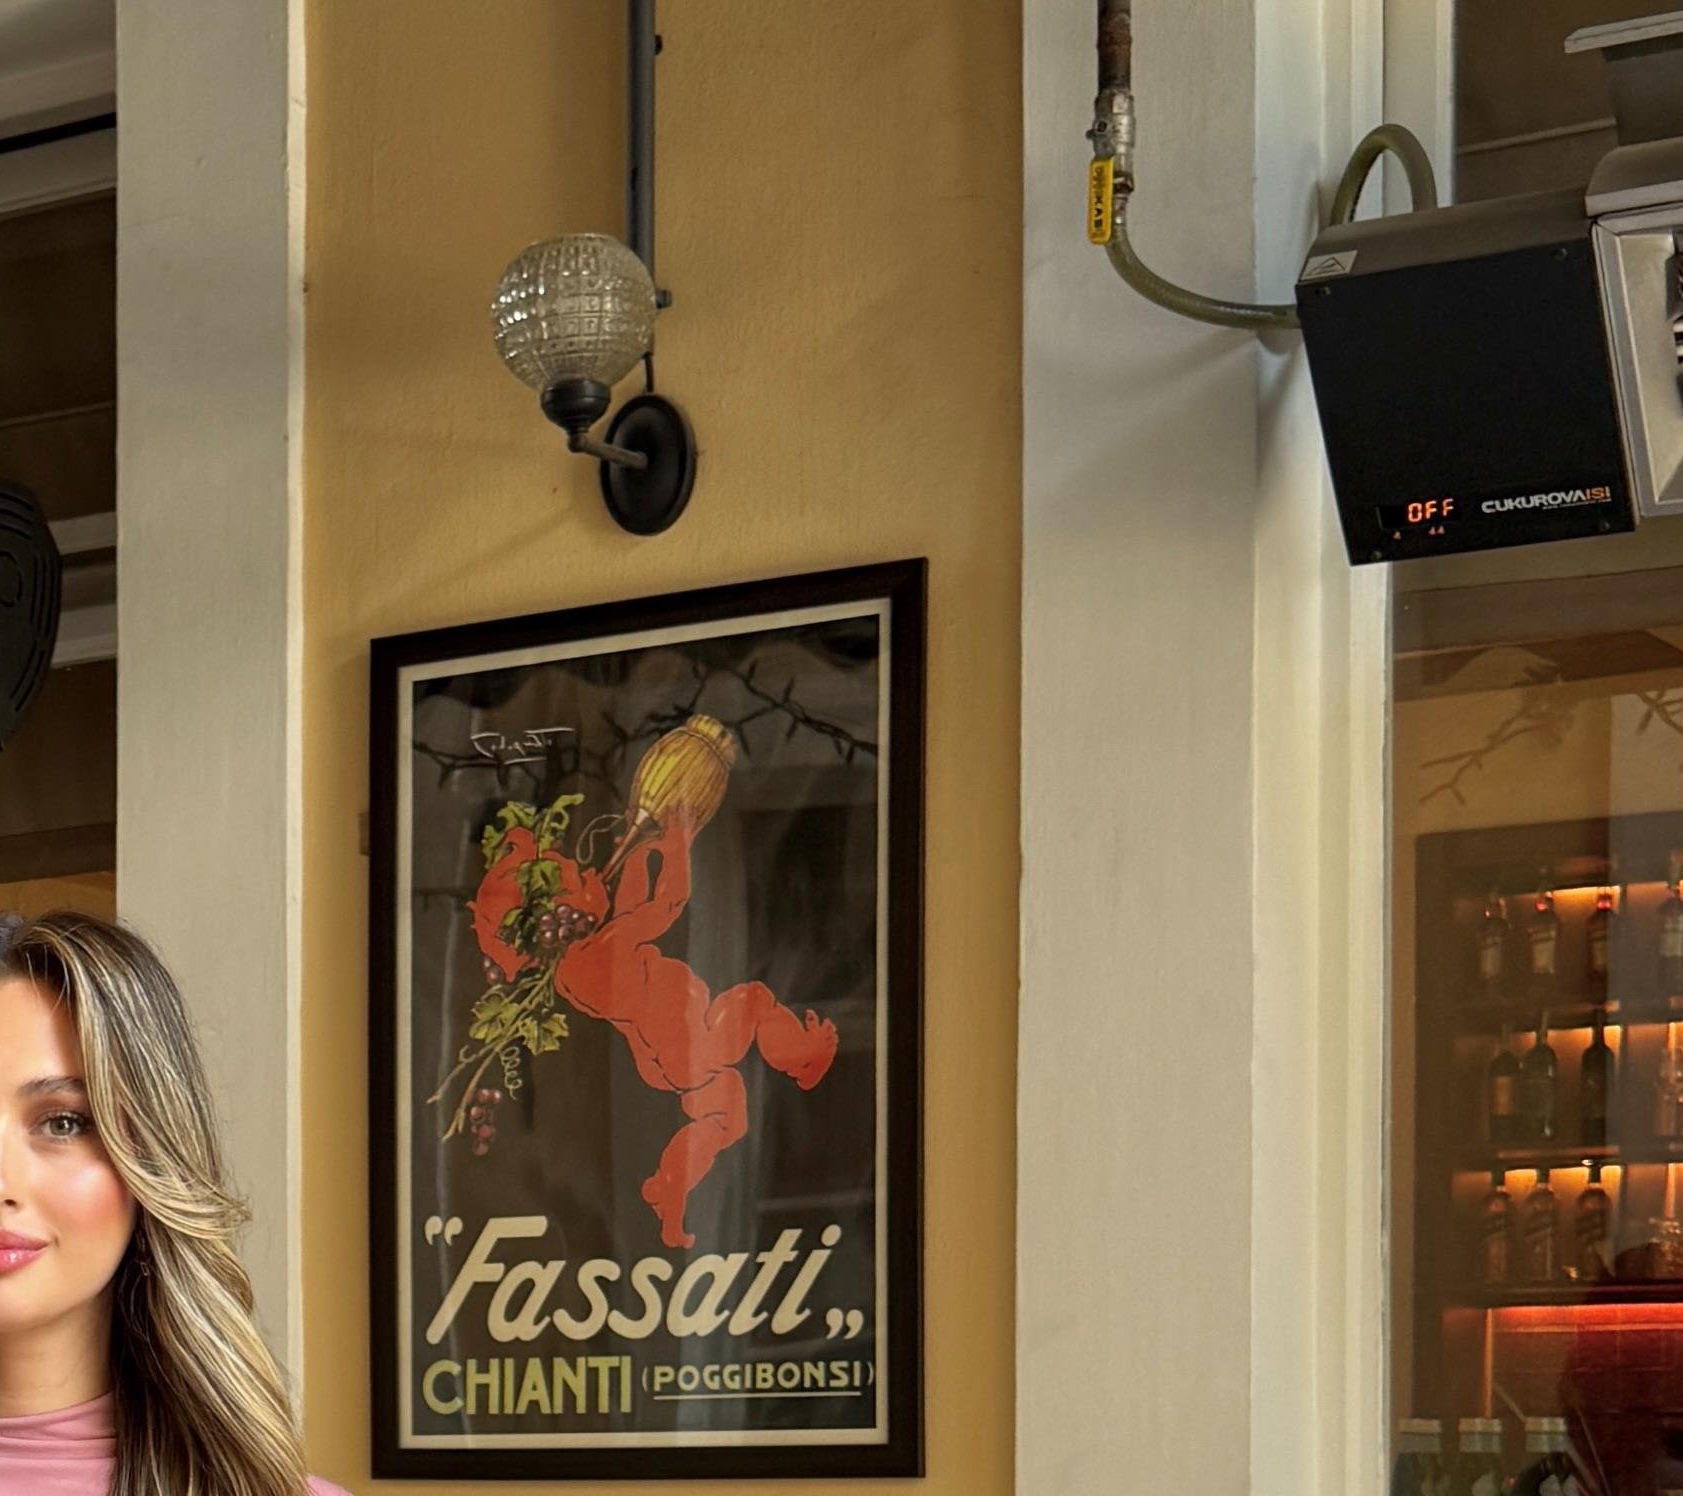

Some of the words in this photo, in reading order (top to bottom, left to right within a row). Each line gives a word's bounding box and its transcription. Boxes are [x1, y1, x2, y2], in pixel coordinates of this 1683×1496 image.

[1408, 498, 1454, 523] OFF
[422, 1355, 632, 1415] CHIANTI
[642, 1360, 874, 1393] (POGGIBONSI)
